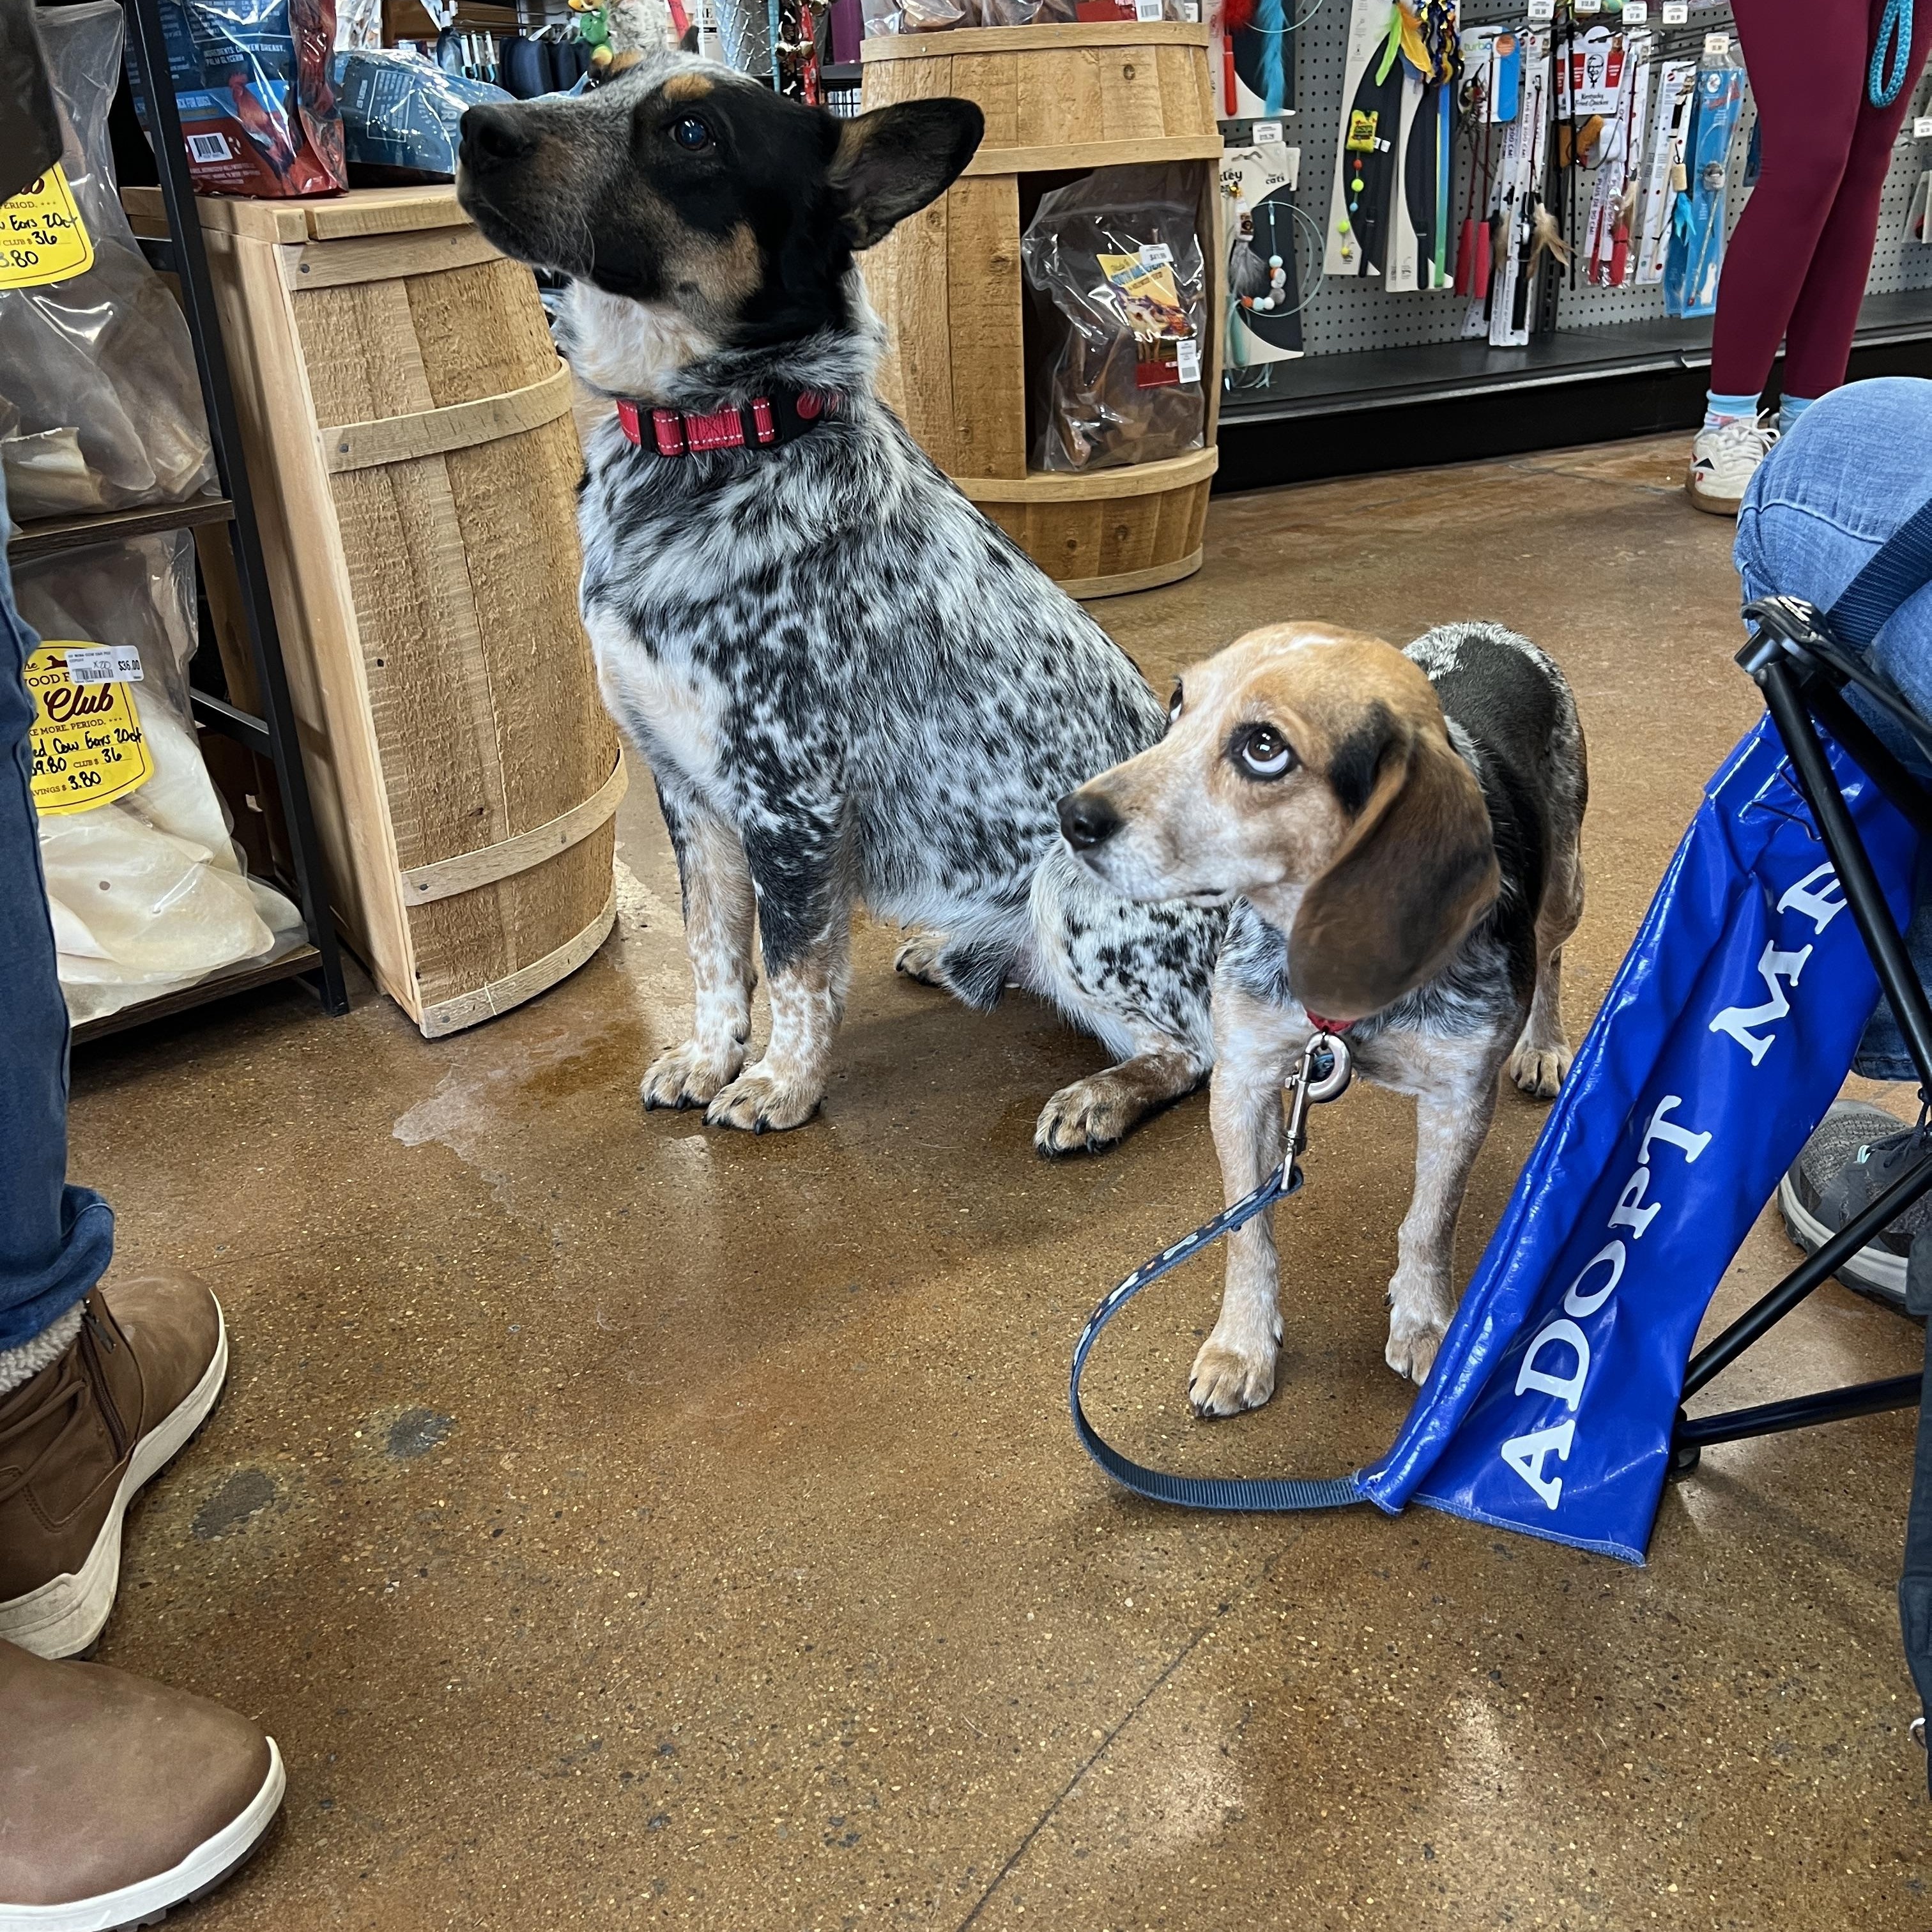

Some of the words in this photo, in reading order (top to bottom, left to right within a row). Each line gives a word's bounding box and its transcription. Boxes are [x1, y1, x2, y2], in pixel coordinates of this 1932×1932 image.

[4, 201, 38, 209] ERIOD.
[31, 231, 57, 245] 36
[43, 682, 114, 723] Club
[53, 738, 79, 754] Cow
[85, 731, 111, 749] Ears
[73, 760, 93, 768] CLUB
[102, 747, 122, 763] 36
[68, 771, 101, 790] 3.80
[1501, 1094, 1712, 1510] ADOPT
[1709, 861, 1848, 1066] ME
